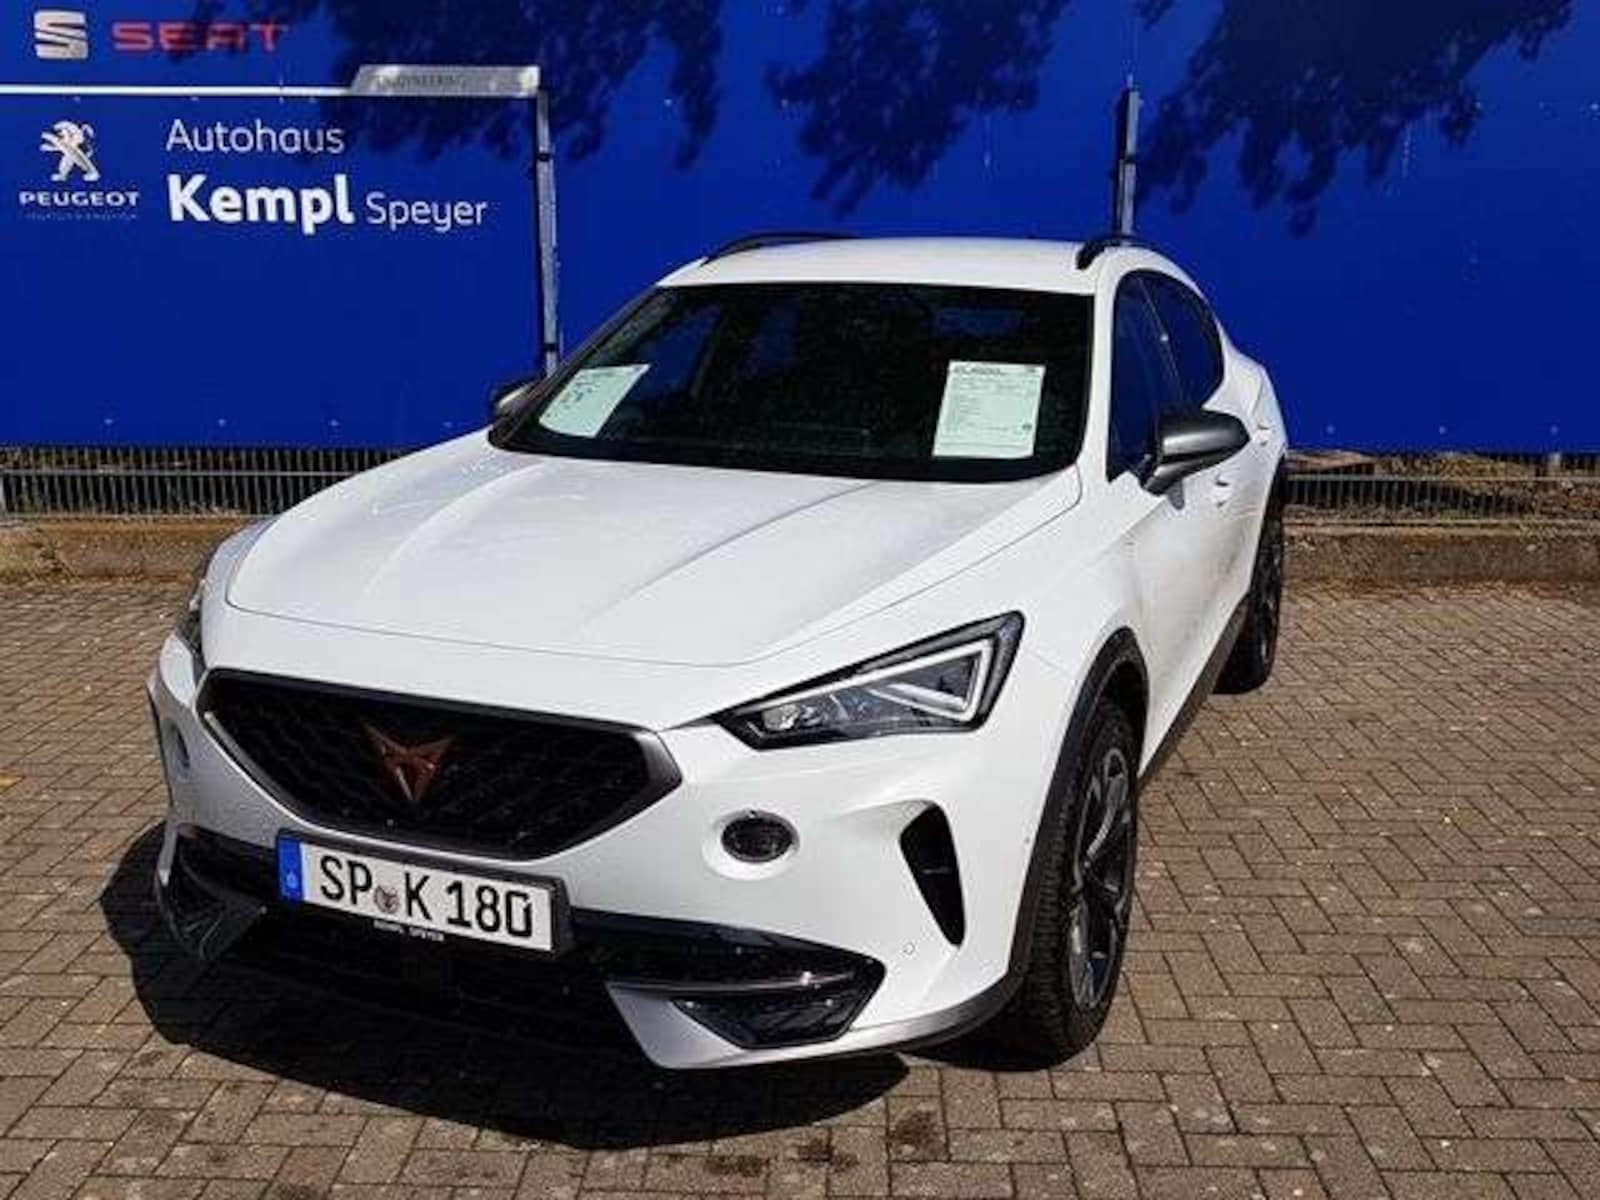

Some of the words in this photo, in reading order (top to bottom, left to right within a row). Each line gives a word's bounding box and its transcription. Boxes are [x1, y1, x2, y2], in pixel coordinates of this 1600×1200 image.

[111, 22, 288, 52] SEAT
[167, 119, 345, 154] Autohaus
[19, 191, 139, 207] PEUGEOT
[168, 173, 354, 234] Kempl
[366, 193, 487, 231] Speyer
[319, 855, 372, 905] SP
[404, 871, 432, 920] K
[446, 881, 532, 937] 180
